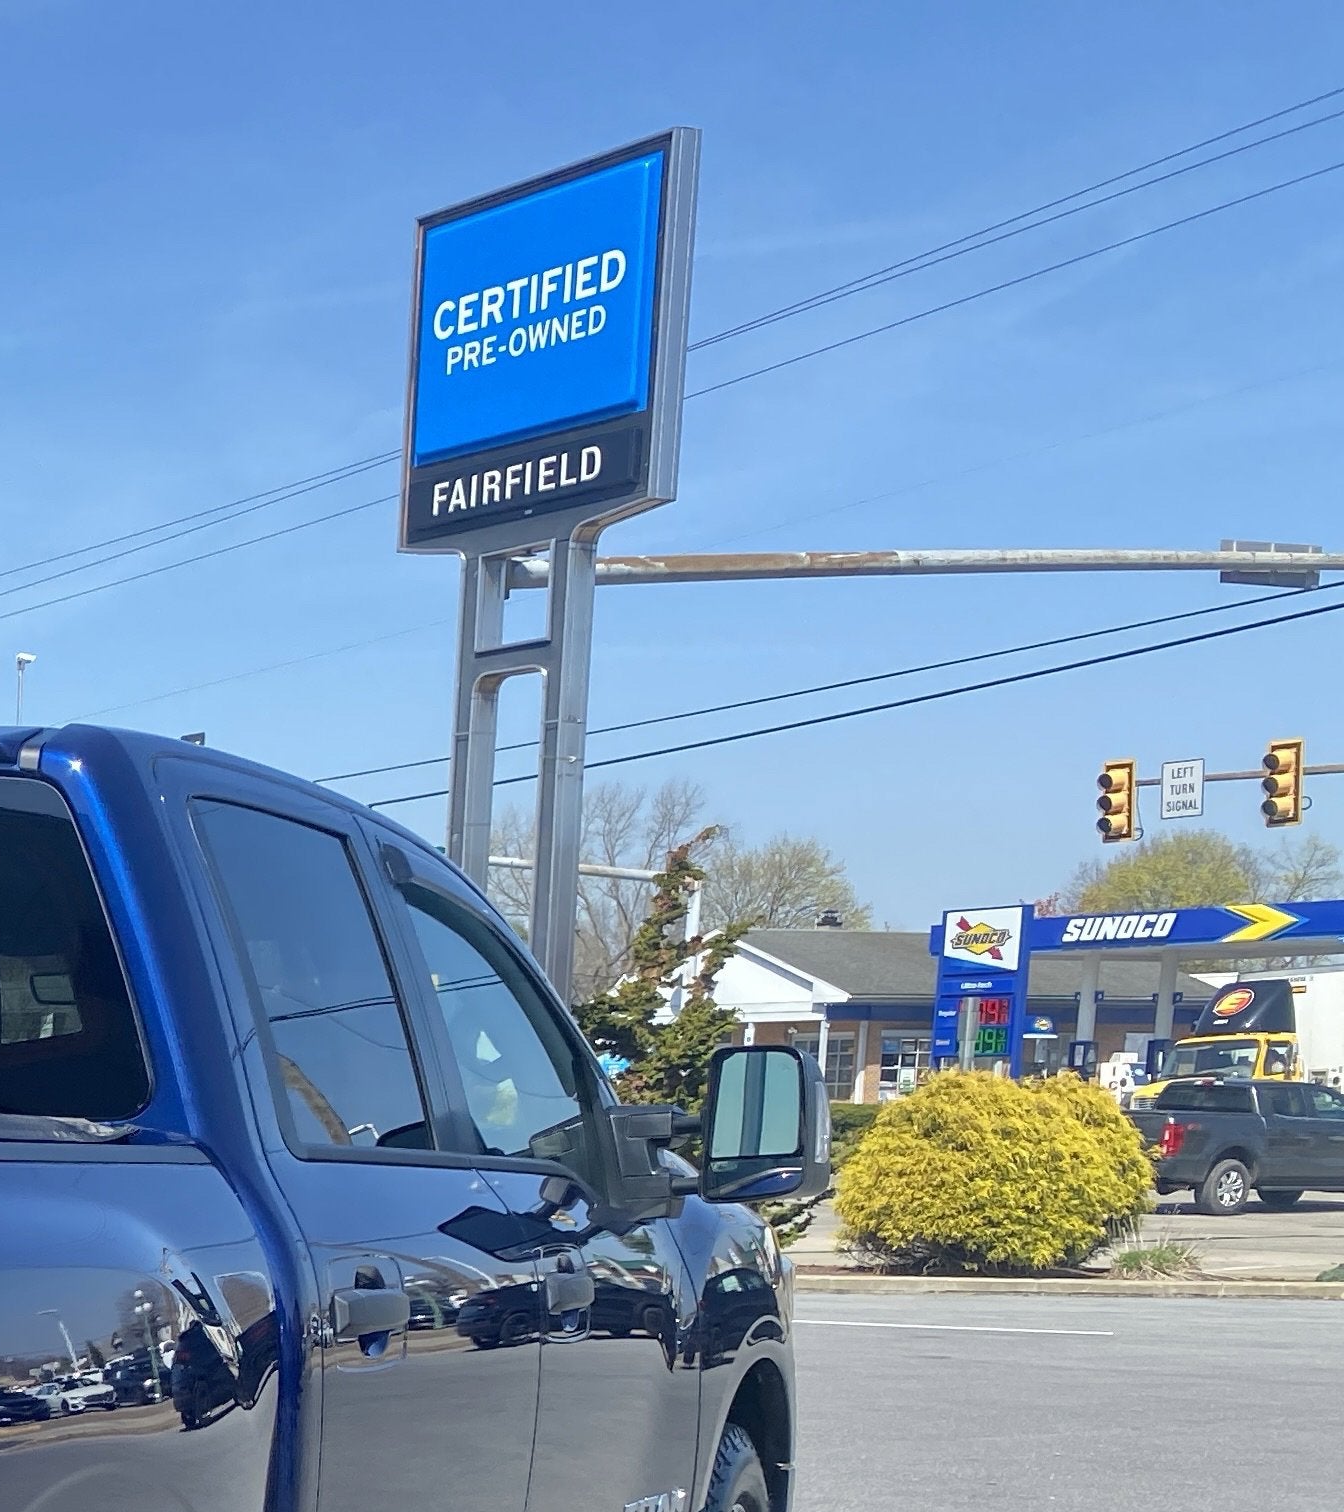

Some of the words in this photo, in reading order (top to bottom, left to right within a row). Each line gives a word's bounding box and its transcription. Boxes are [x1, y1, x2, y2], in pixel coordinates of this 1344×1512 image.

[433, 249, 627, 340] CERTIFIED
[446, 305, 607, 375] PRE-OWNED
[432, 445, 602, 516] FAIRFIELD
[1171, 766, 1195, 780] LEFT
[1170, 783, 1195, 796] TURN
[1166, 799, 1199, 813] SIGNAL
[954, 929, 1007, 948] SUNOCO
[1062, 913, 1178, 943] SUNOCO
